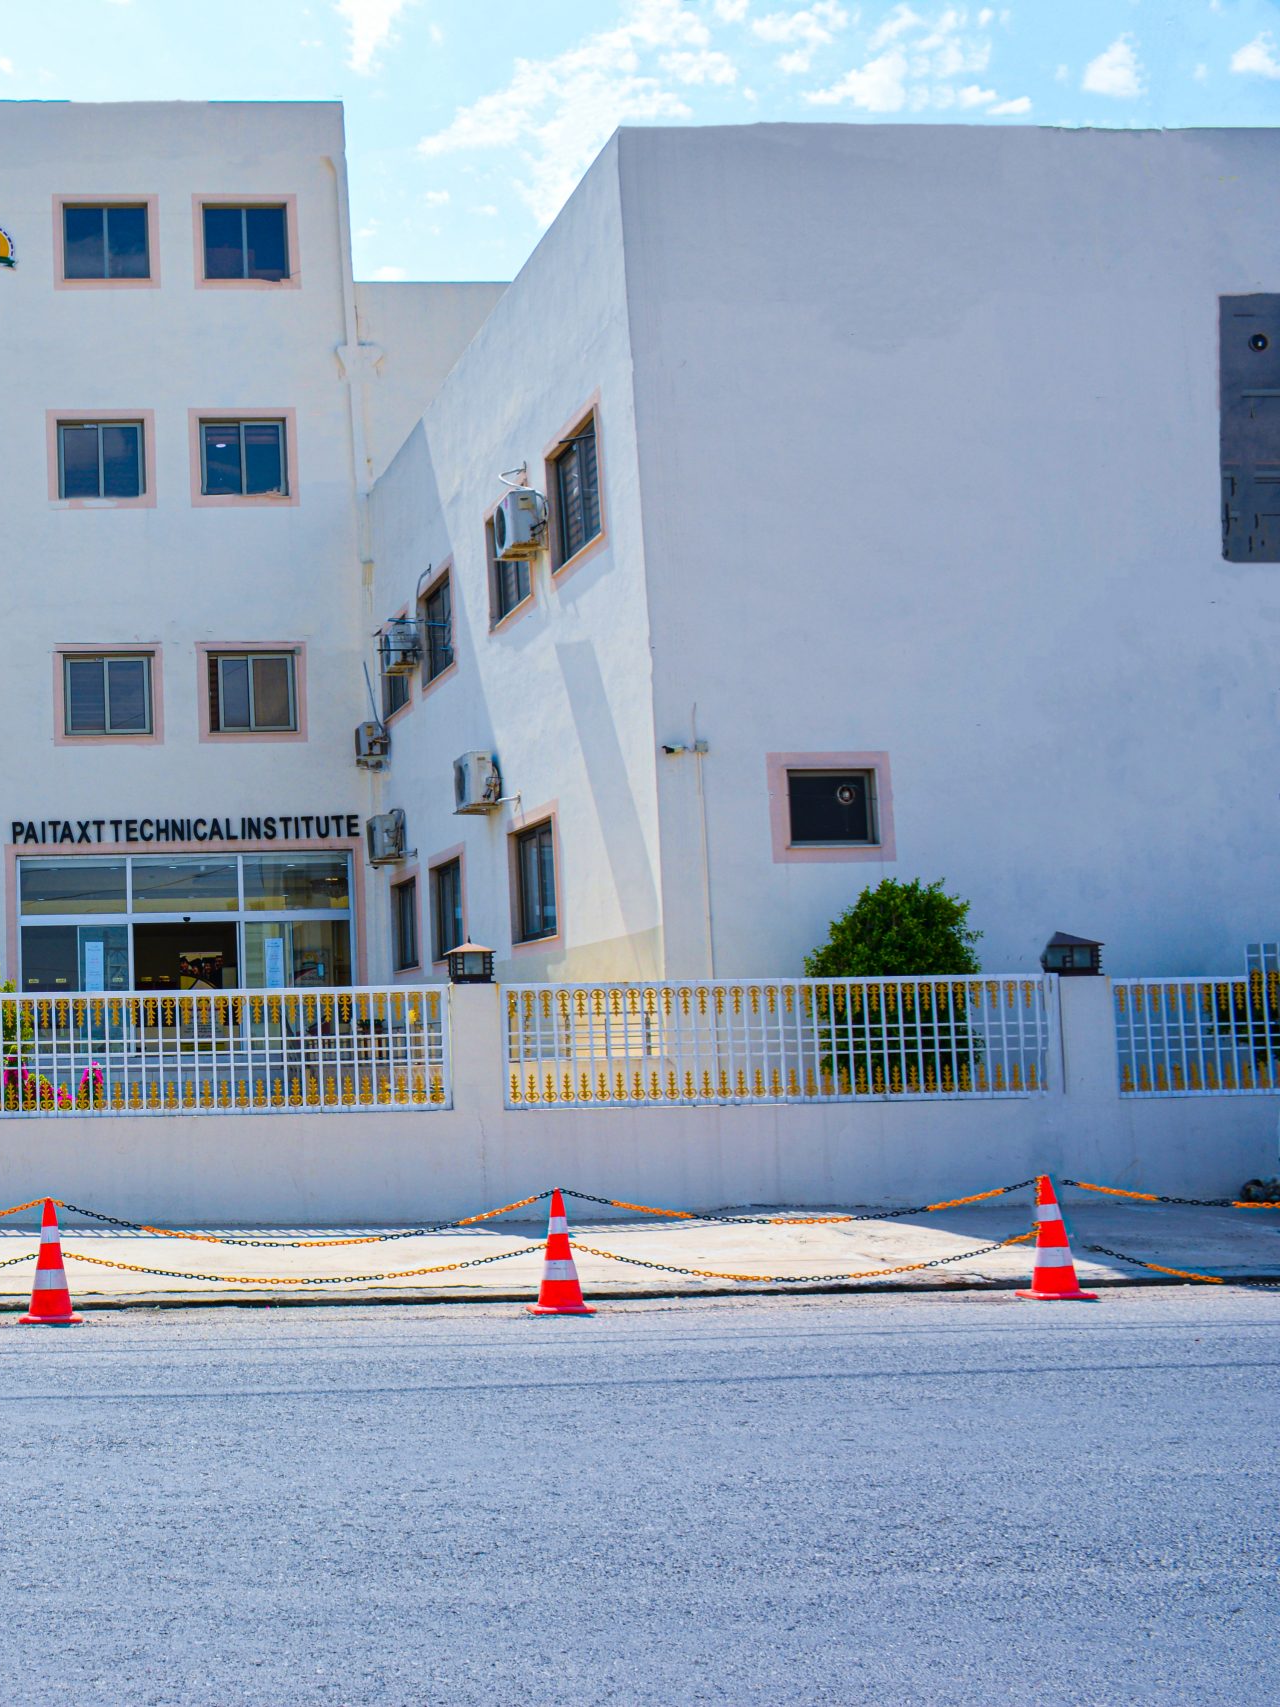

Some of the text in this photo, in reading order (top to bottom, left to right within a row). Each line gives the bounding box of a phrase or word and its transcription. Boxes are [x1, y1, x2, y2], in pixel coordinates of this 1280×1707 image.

[12, 815, 360, 844] PAITAXT TECHNICAL INSTITUTE
